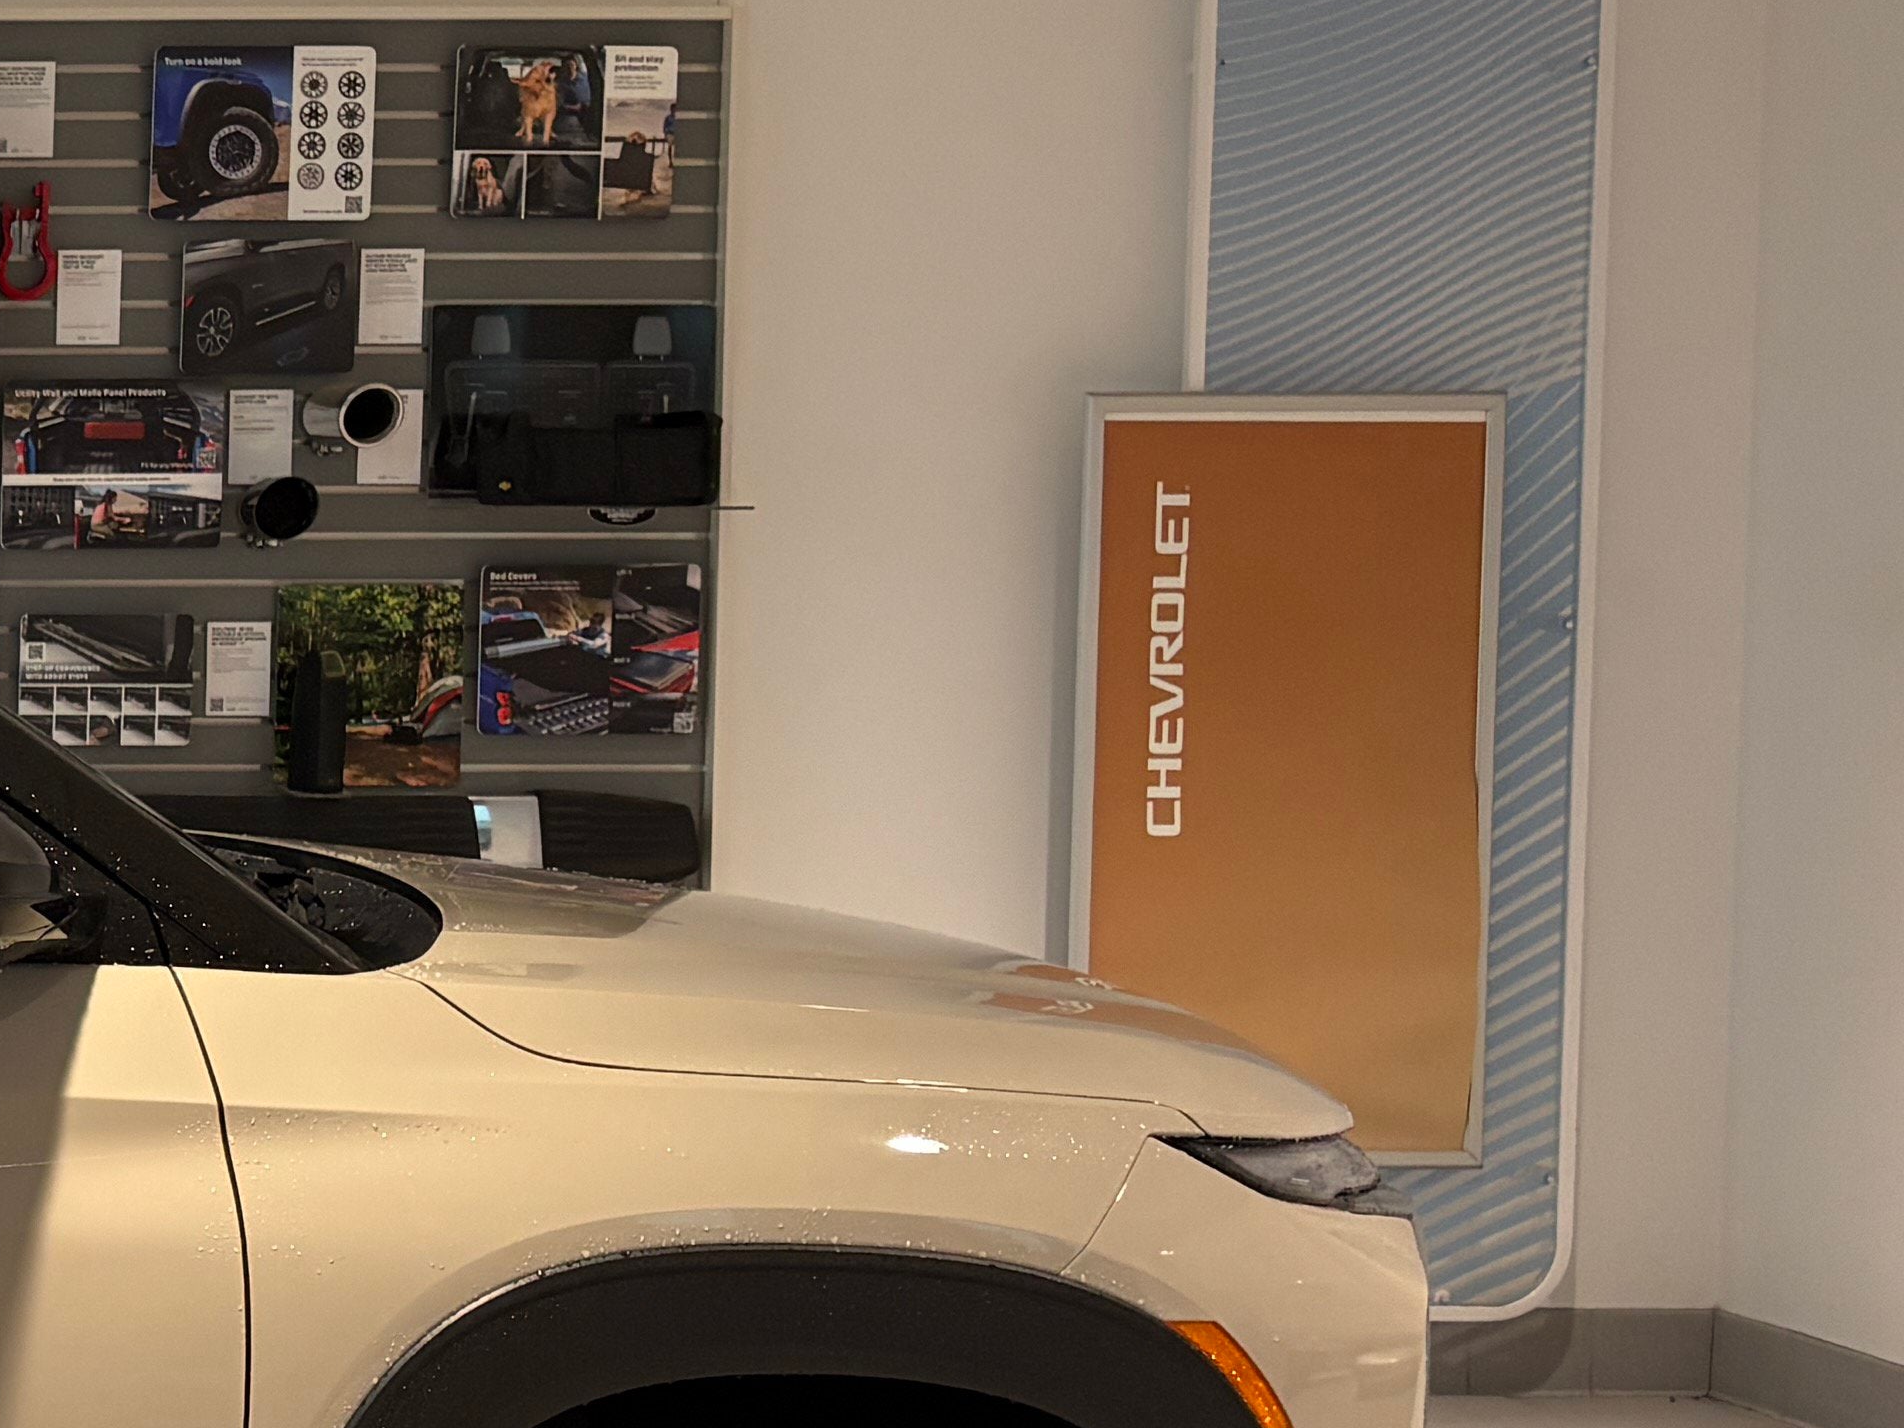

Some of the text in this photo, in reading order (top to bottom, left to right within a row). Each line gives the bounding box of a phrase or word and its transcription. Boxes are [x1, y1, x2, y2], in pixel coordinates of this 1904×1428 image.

[164, 57, 184, 66] Turn
[204, 57, 223, 66] bold
[62, 388, 78, 397] and
[103, 388, 127, 397] Panel
[128, 388, 167, 397] Products
[1145, 480, 1190, 837] CHEVROLET
